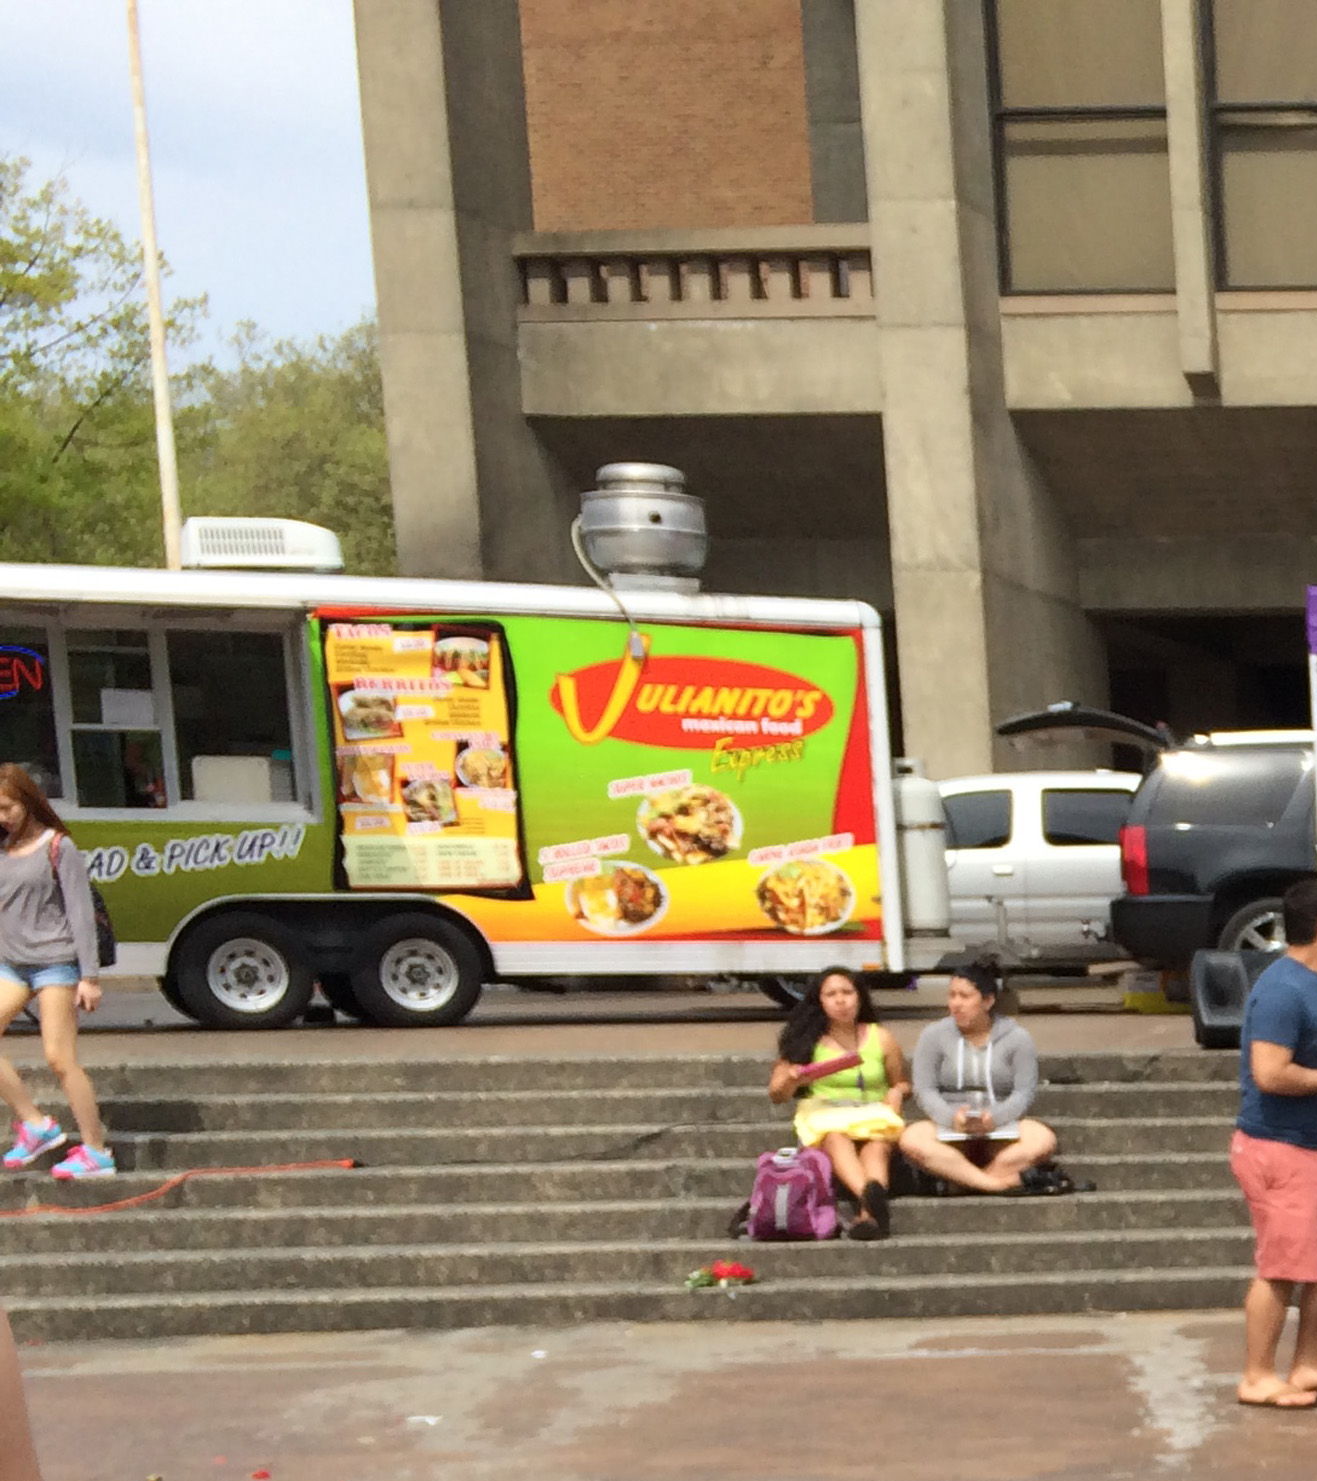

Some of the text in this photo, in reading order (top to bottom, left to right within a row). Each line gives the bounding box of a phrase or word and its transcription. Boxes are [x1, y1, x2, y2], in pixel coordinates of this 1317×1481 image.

[761, 717, 803, 735] food
[711, 736, 805, 782] Express
[135, 846, 155, 870] &
[166, 837, 230, 870] PICK
[237, 826, 302, 861] UP!!
